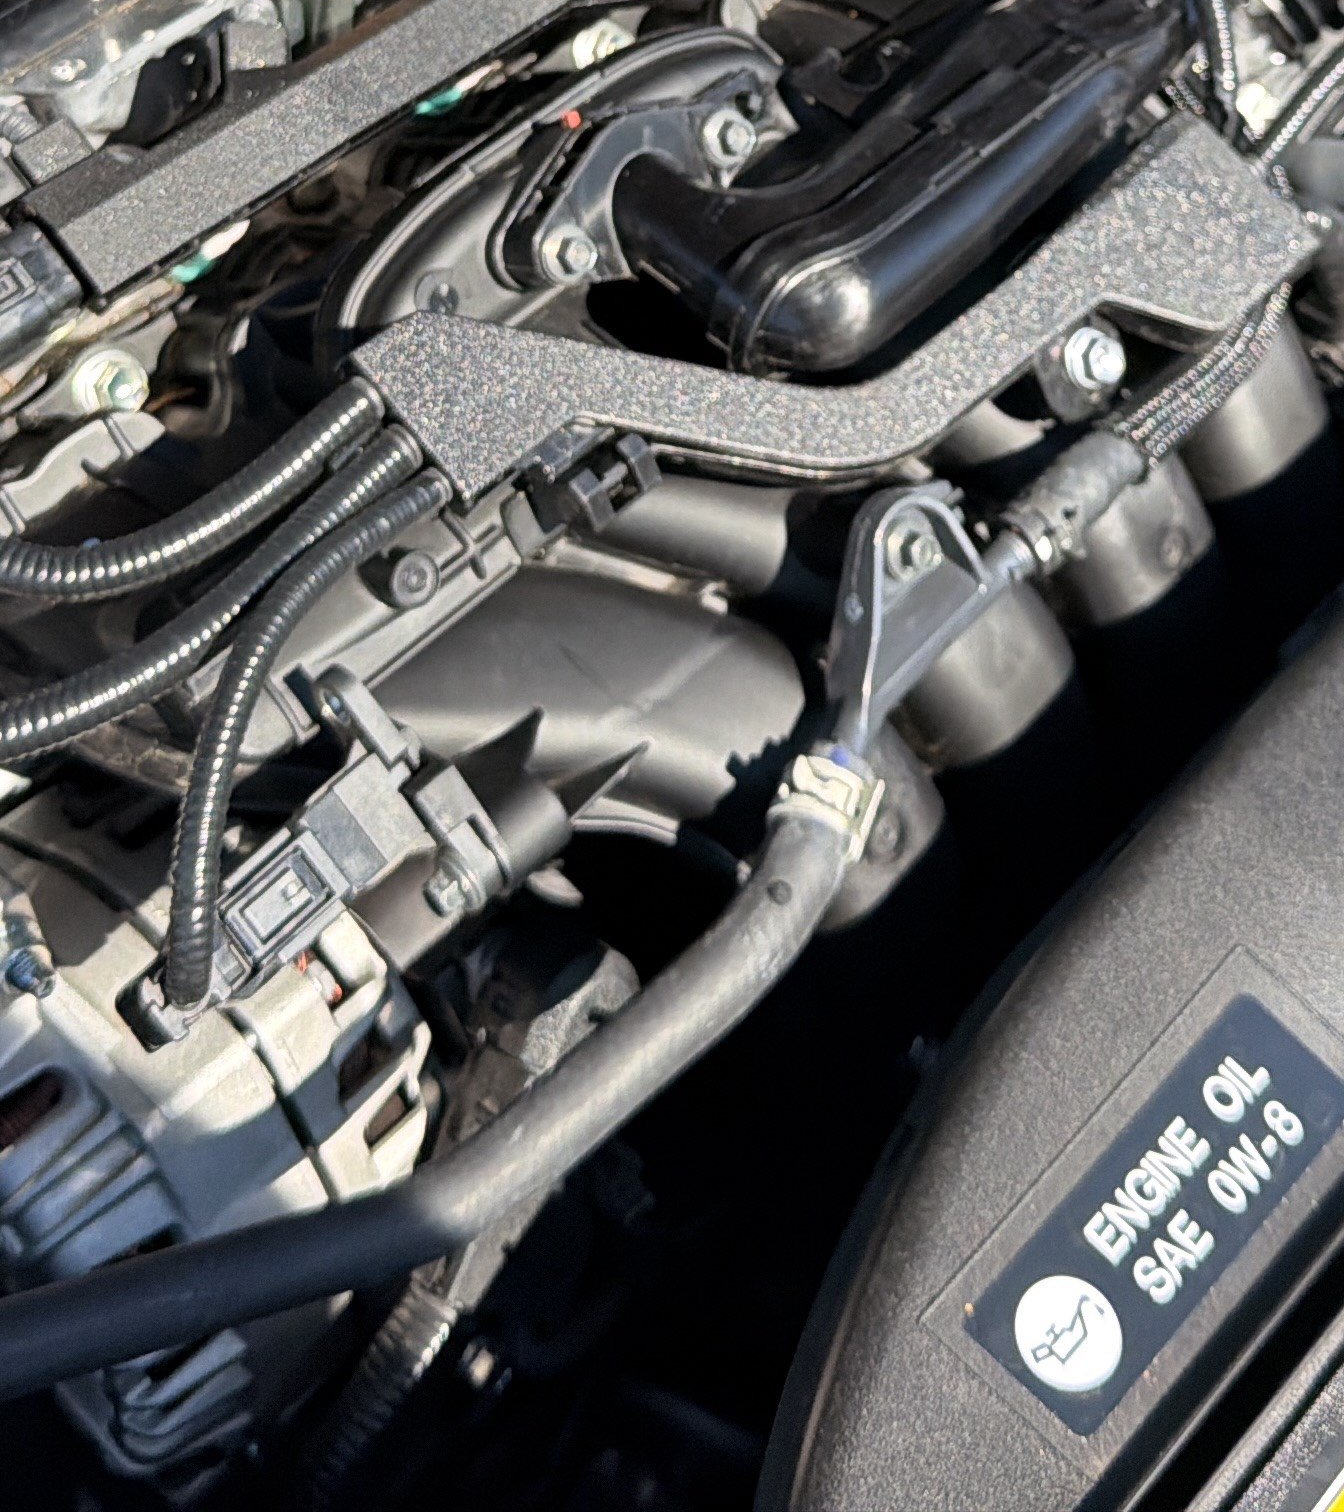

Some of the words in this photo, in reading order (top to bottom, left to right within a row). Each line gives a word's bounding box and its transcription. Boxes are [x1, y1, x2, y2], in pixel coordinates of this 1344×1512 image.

[1083, 1116, 1212, 1267] ENGINE
[1202, 1055, 1272, 1124] OIL
[1133, 1208, 1215, 1304] SAE
[1207, 1099, 1305, 1215] 0W-8
